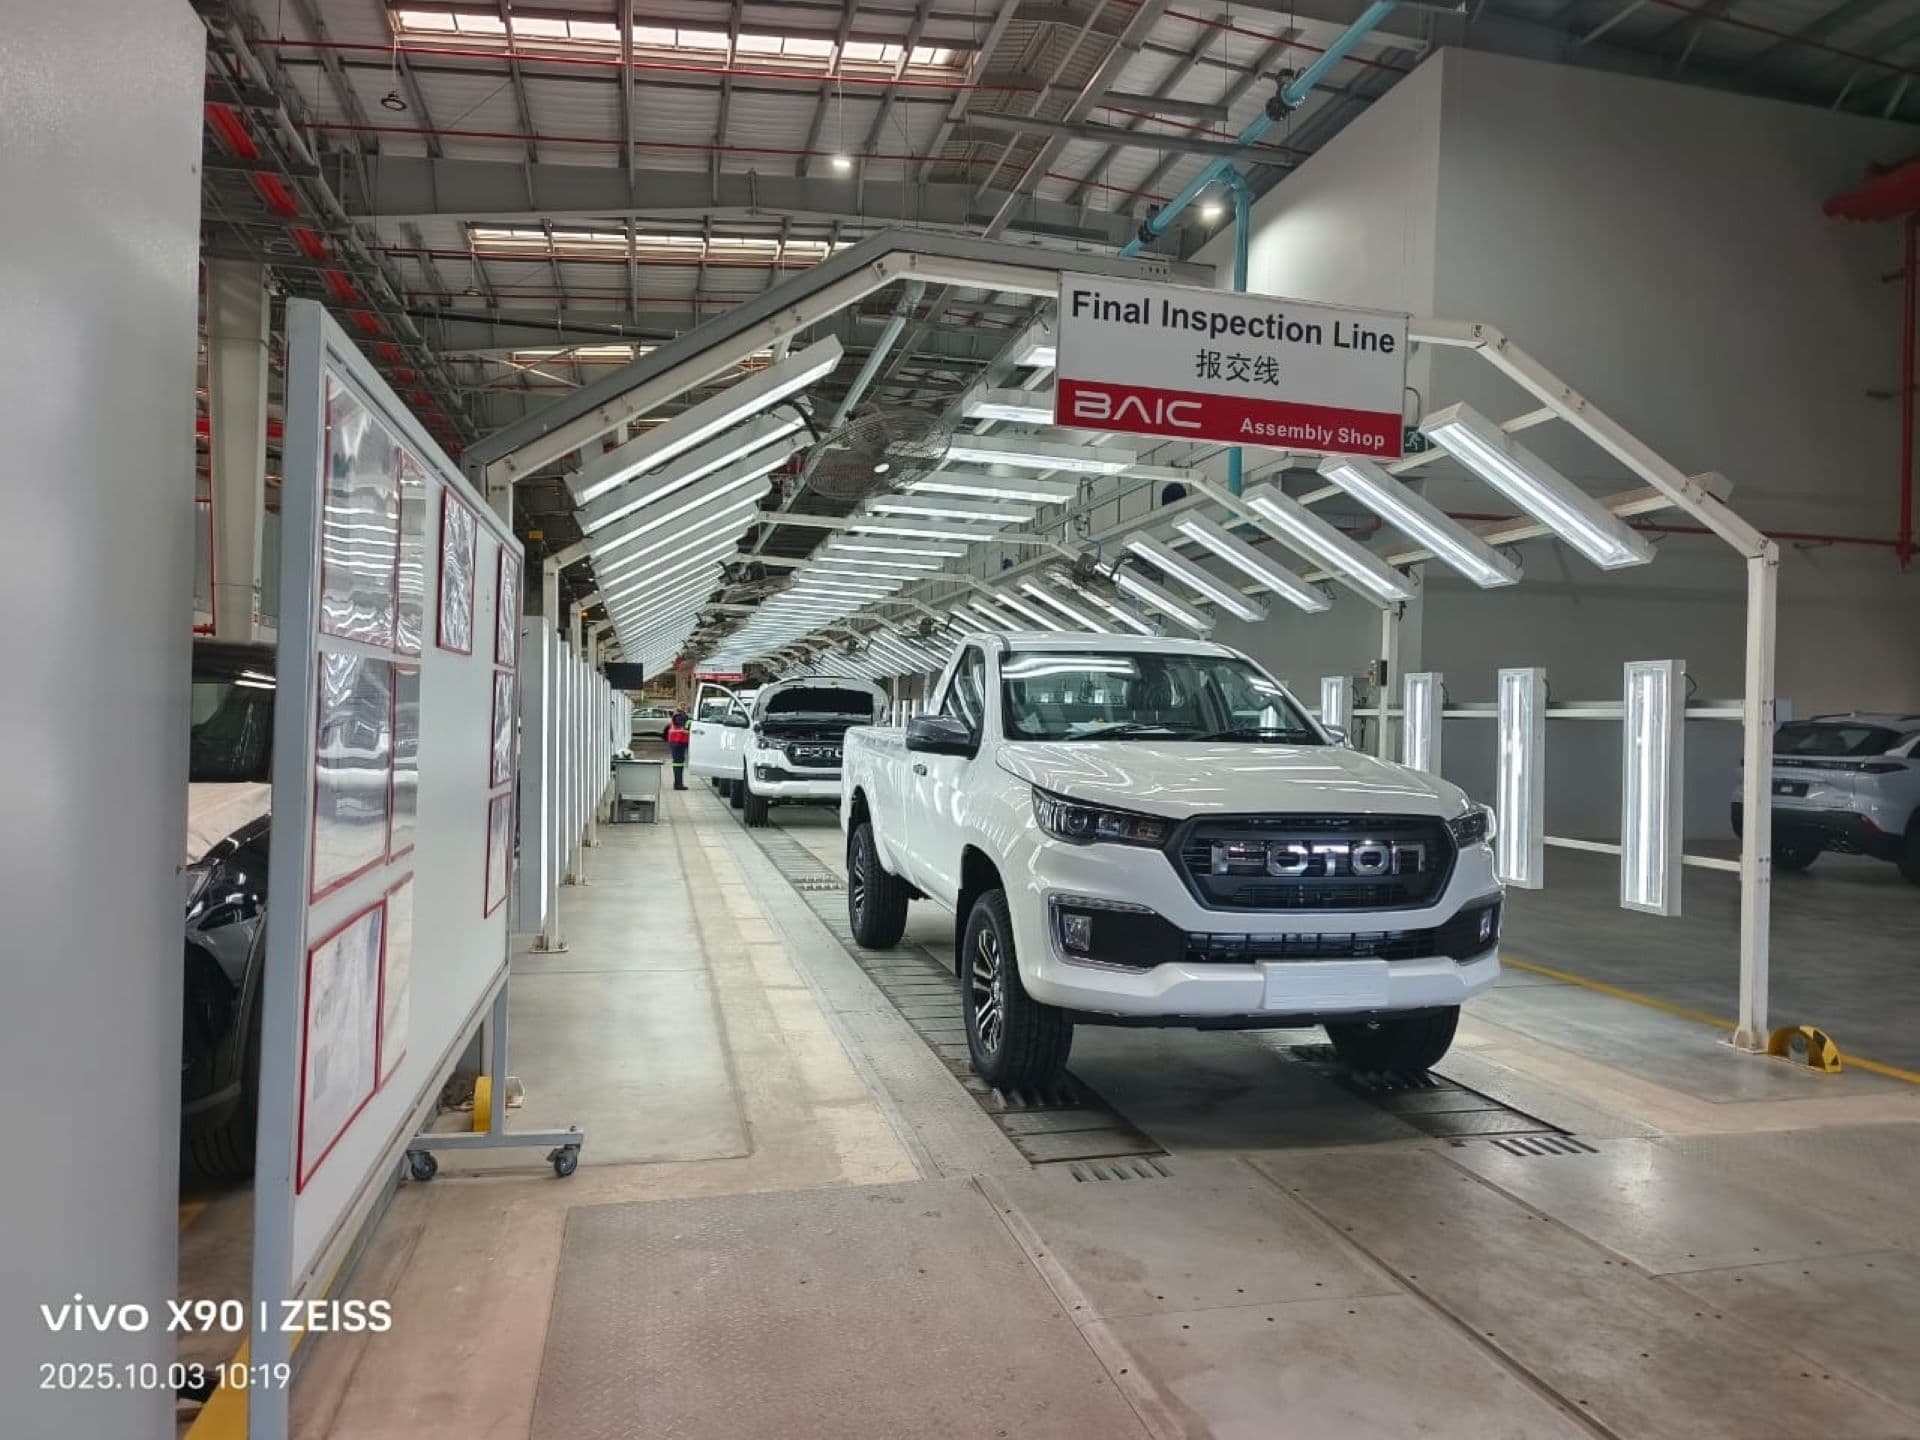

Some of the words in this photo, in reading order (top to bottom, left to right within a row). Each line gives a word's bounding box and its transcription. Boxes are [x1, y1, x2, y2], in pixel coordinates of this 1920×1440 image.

[1072, 290, 1149, 325] Final
[1162, 300, 1322, 345] Inspection
[1334, 321, 1395, 353] Line
[1195, 348, 1280, 386] 报交线
[1074, 390, 1202, 429] BAIC
[1240, 418, 1333, 445] Assembly
[1338, 427, 1385, 449] Shop
[1211, 840, 1425, 877] FOTON
